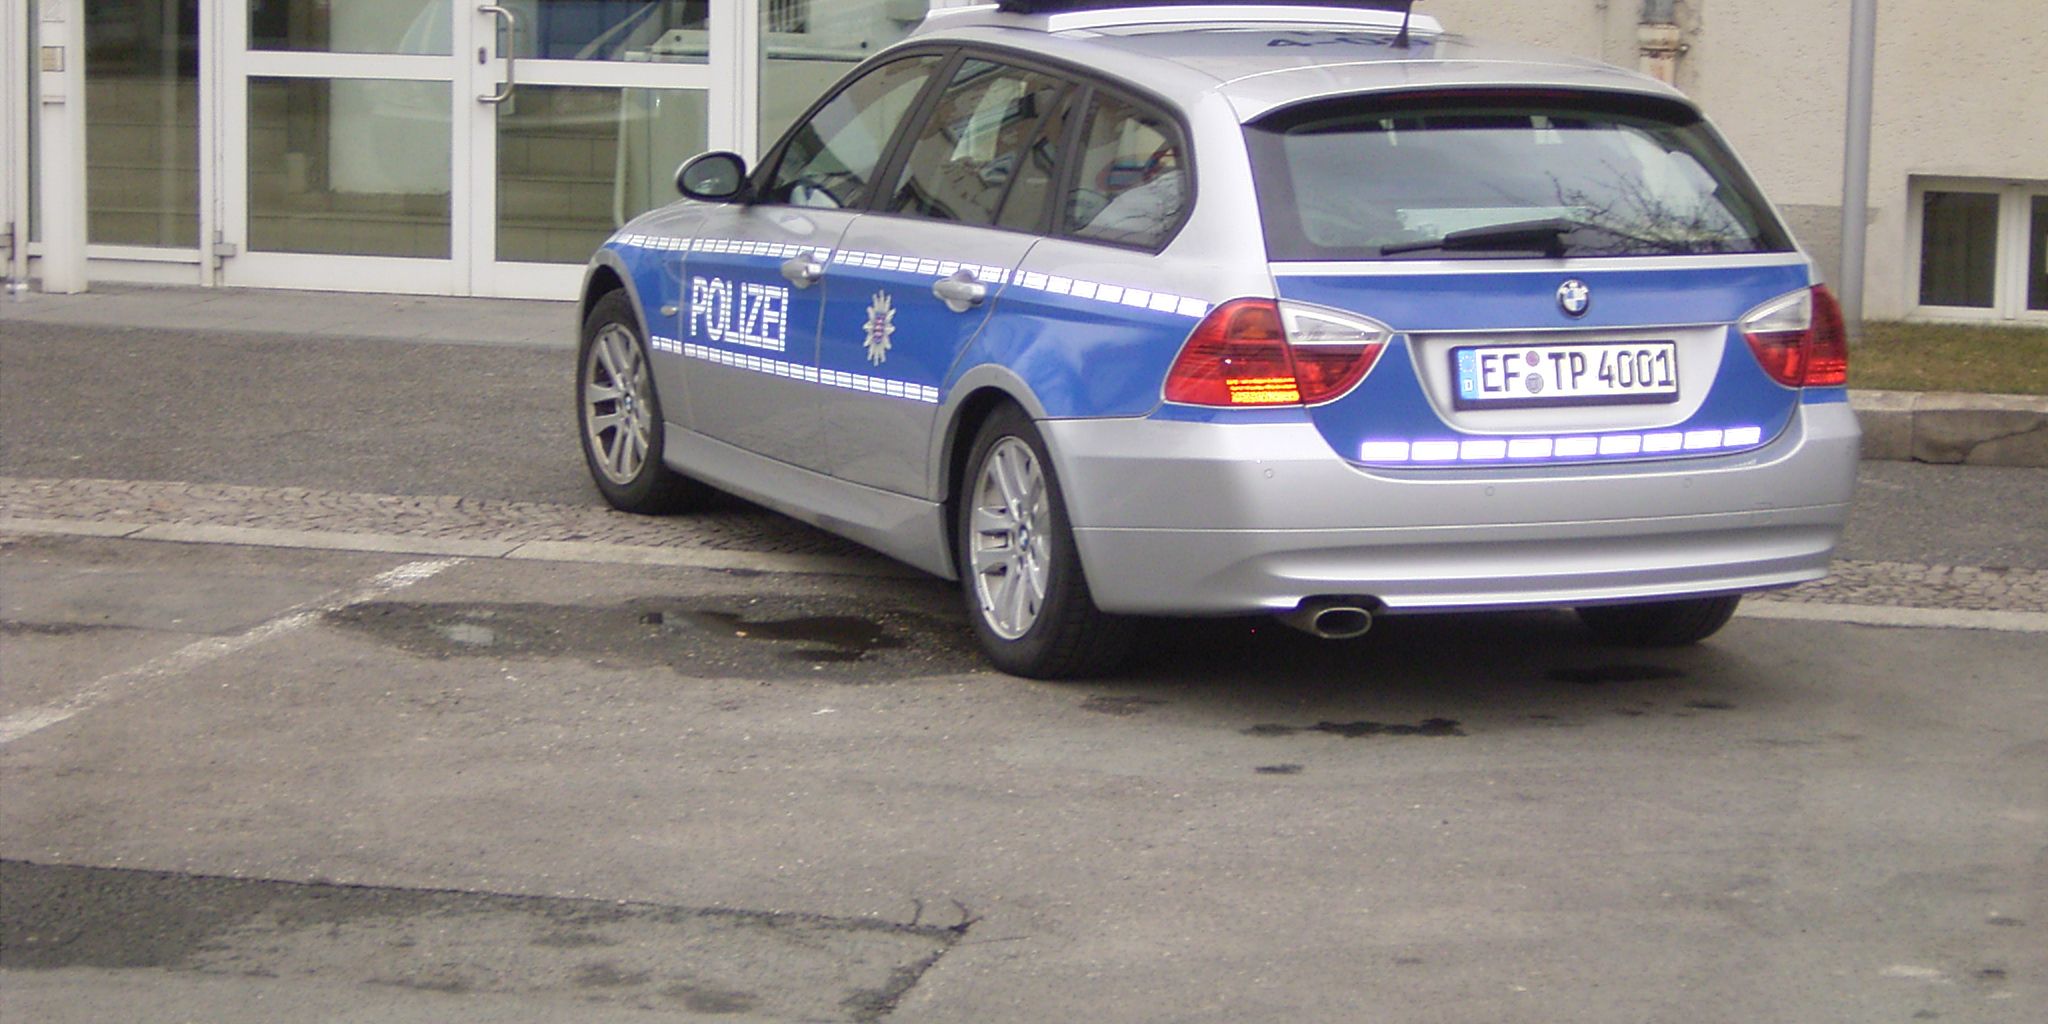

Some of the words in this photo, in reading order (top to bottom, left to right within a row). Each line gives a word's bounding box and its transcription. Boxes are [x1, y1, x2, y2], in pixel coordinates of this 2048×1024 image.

[690, 275, 789, 352] POLIZEI
[1480, 353, 1521, 393] EF
[1548, 351, 1588, 390] TP
[1598, 348, 1675, 389] 4001
